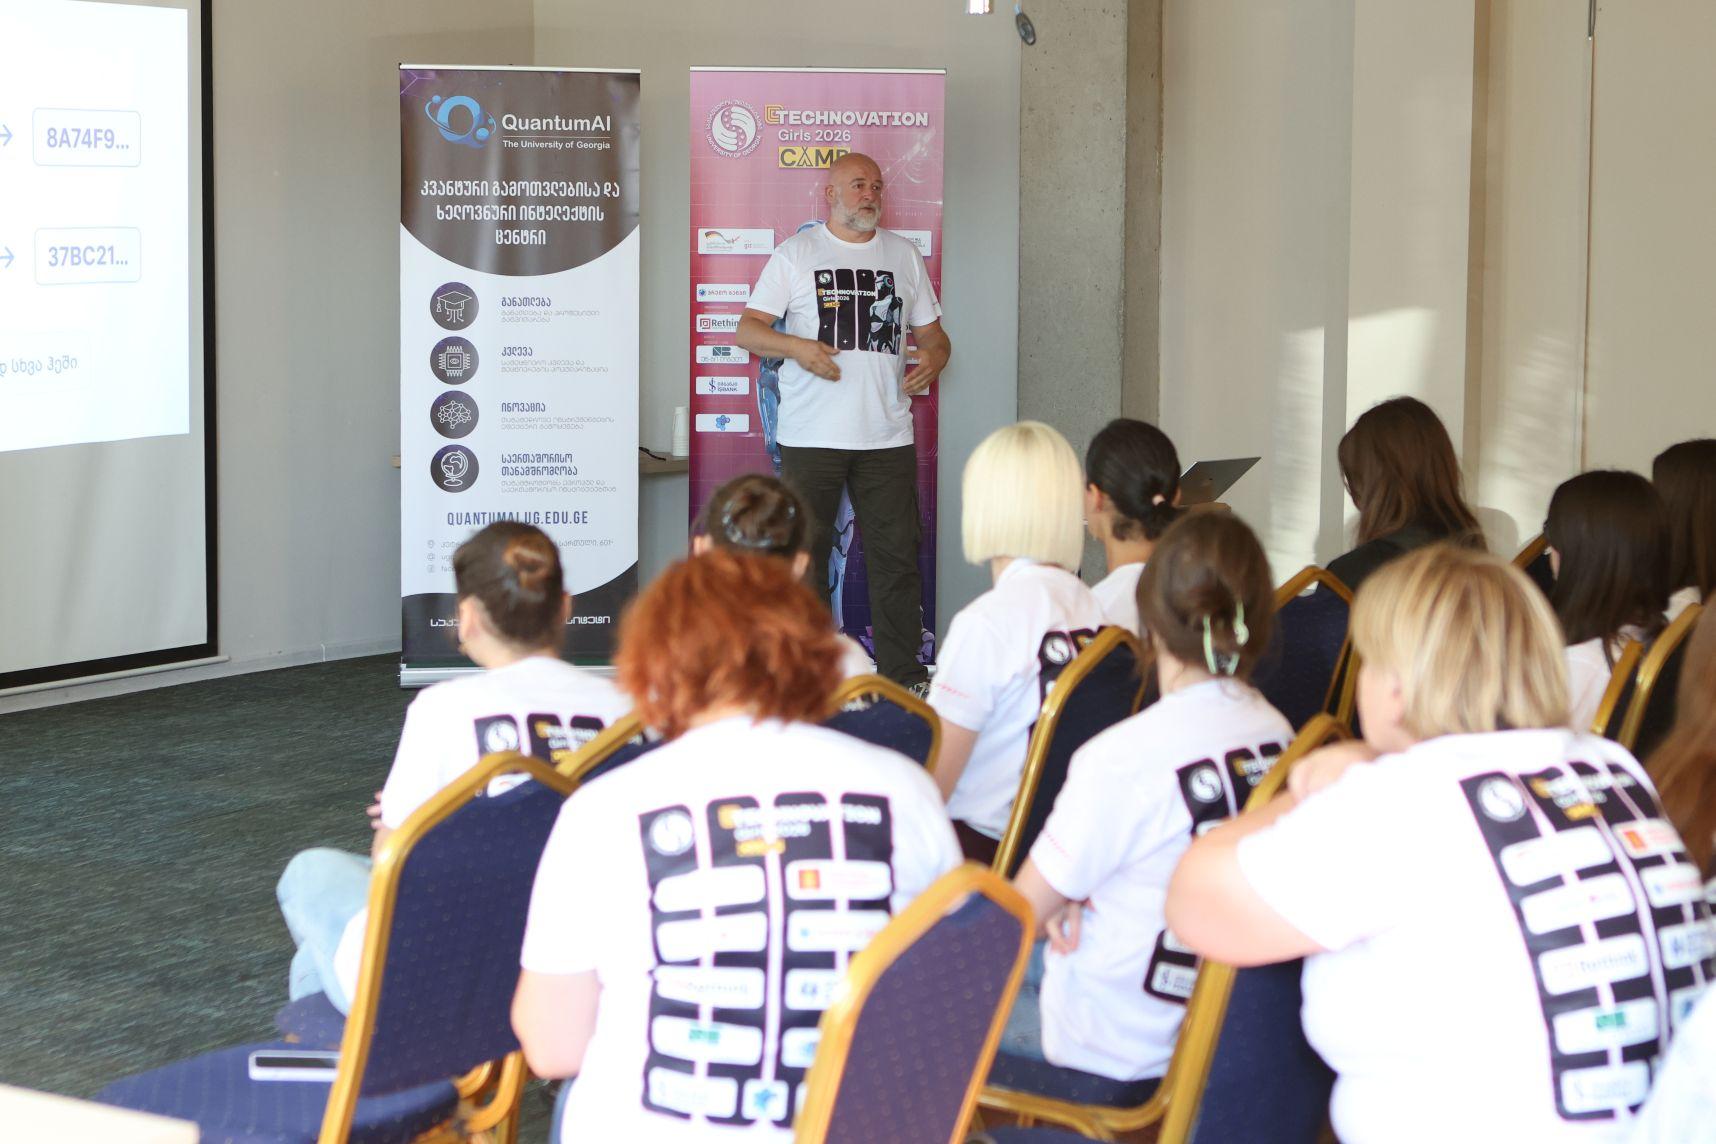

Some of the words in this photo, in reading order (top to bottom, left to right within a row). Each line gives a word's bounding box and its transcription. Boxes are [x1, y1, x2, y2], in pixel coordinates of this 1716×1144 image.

[501, 113, 611, 131] QuantumAI
[776, 109, 929, 127] TECHNOVATION
[46, 126, 130, 150] 8A74F9...
[778, 128, 812, 142] Girls
[816, 128, 851, 142] 2026
[502, 140, 519, 148] The
[520, 140, 563, 150] University
[565, 140, 574, 148] of
[576, 141, 611, 150] Georgia
[420, 180, 489, 197] კვანტური
[492, 180, 601, 197] გამოთვლებისა
[603, 181, 620, 198] და
[436, 205, 517, 221] ხელოვნური
[519, 205, 605, 221] ინტელექტის
[495, 229, 547, 246] ცენტრი
[47, 244, 129, 268] 37BC21...
[501, 296, 552, 307] განათლება
[711, 318, 740, 327] Rethin
[501, 346, 533, 357] კვლევა
[501, 402, 546, 413] ინოვაცია
[501, 453, 573, 464] საერთაშორისო
[501, 465, 578, 476] თანამშრომლობა
[447, 511, 589, 526] QUANTUMAIUG.EDU.GE
